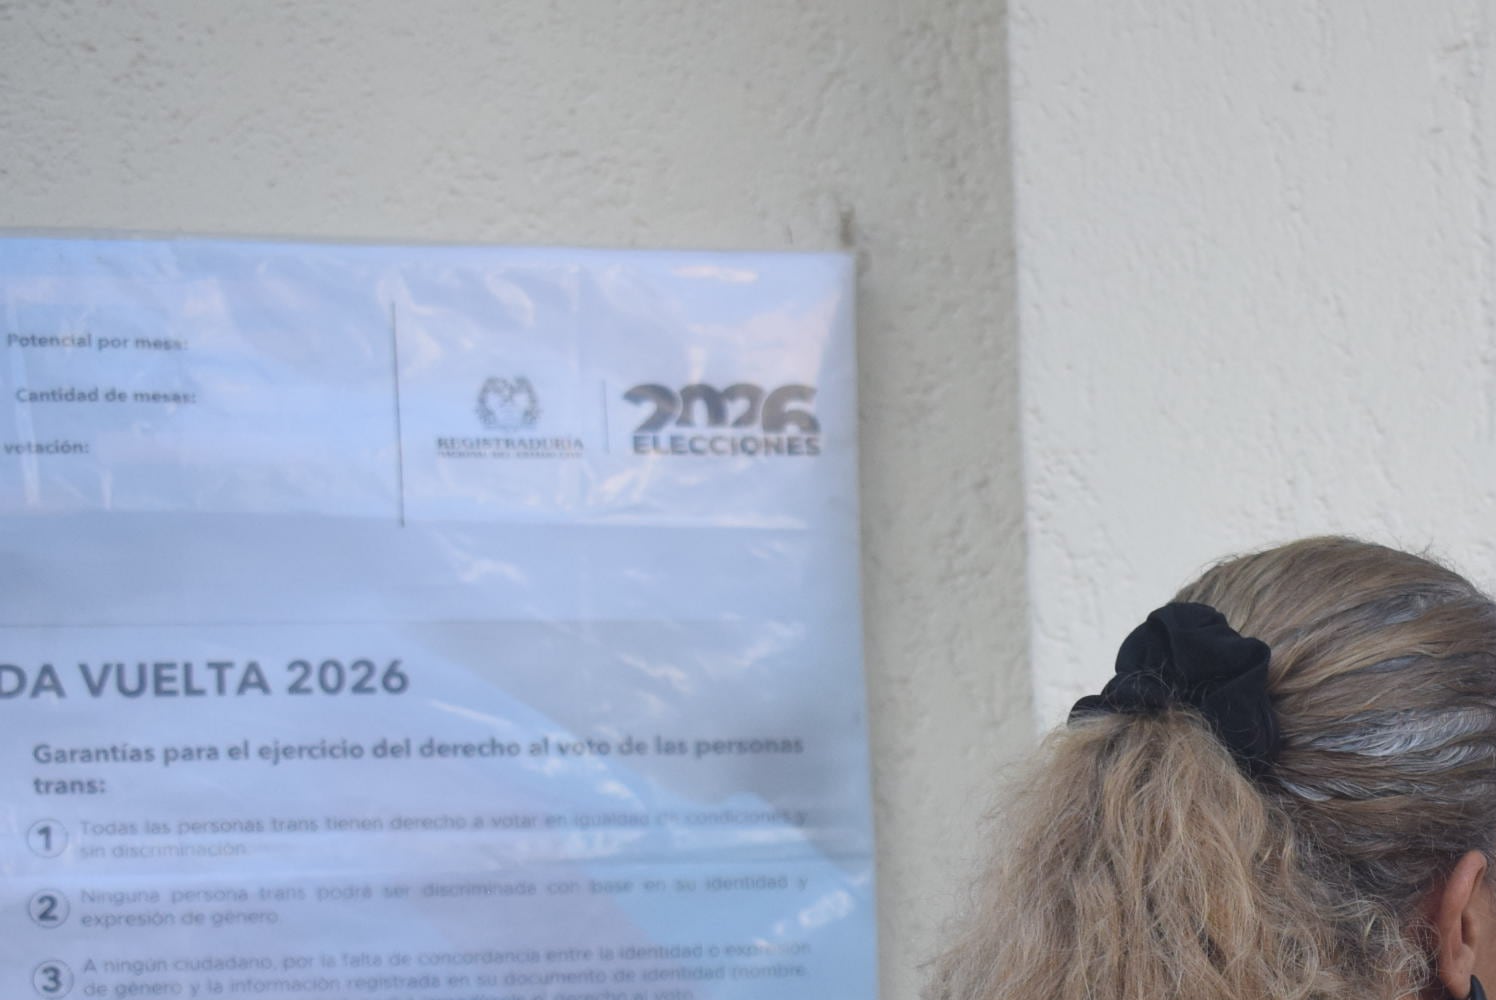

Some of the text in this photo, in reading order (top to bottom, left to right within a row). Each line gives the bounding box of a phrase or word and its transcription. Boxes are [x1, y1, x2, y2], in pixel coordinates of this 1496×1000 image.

[7, 333, 92, 349] Potencial
[98, 337, 128, 352] por
[15, 388, 99, 402] Cantidad
[105, 389, 127, 402] de
[4, 439, 90, 455] votación:
[633, 434, 821, 456] ELECCIONES
[78, 661, 271, 698] VUELTA
[286, 659, 410, 696] 2026
[33, 735, 804, 767] Garantías para el ejercicio del derecho al voto de las personas
[33, 775, 106, 796] trans:
[80, 820, 138, 837] Todas
[144, 819, 171, 835] las
[177, 819, 265, 838] personas
[271, 818, 319, 833] trans
[325, 816, 384, 832] tienen
[391, 814, 467, 831] derecho
[473, 817, 484, 829] a
[491, 814, 537, 829] votar
[37, 827, 51, 852] 1
[81, 888, 160, 906] Ninguna
[171, 888, 248, 906] persona
[258, 886, 304, 901] trans
[317, 884, 372, 905] podrá
[383, 886, 410, 900] ser
[422, 880, 537, 898] discriminada
[547, 880, 580, 894] con
[590, 878, 633, 894] base
[643, 880, 667, 892] en
[675, 880, 696, 892] su
[705, 875, 788, 892] identidad
[37, 896, 58, 922] 2
[81, 911, 175, 930] expresión
[181, 910, 205, 925] de
[83, 957, 97, 973] A
[103, 956, 167, 976] ningún
[283, 956, 314, 973] por
[321, 952, 337, 968] la
[343, 951, 382, 968] falta
[388, 951, 411, 967] de
[418, 949, 540, 966] concordancia
[546, 947, 594, 963] entre
[619, 942, 703, 961] identidad
[41, 967, 63, 993] 3
[84, 980, 108, 997] de
